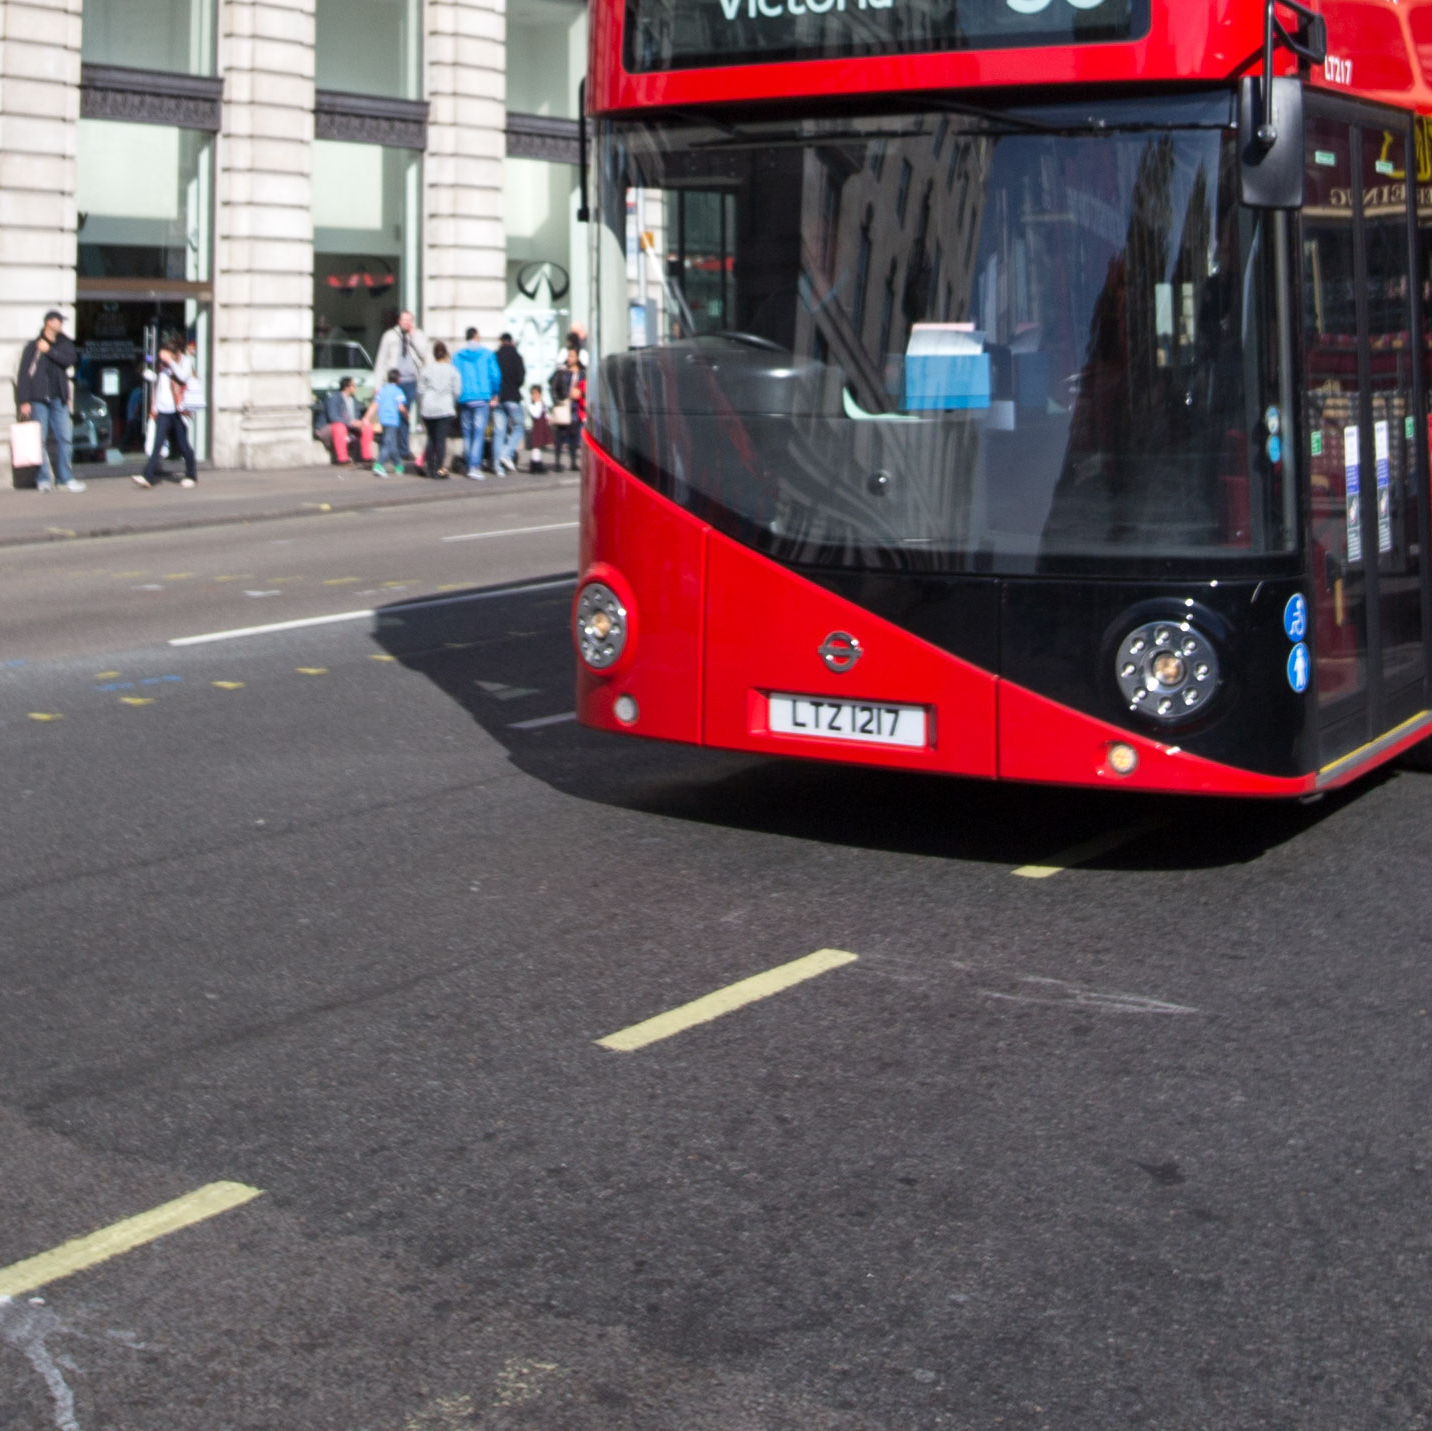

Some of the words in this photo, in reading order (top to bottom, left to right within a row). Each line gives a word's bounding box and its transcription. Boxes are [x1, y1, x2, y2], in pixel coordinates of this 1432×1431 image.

[1324, 55, 1353, 86] LT217
[791, 698, 843, 732] LTZ
[851, 704, 901, 737] 1217
